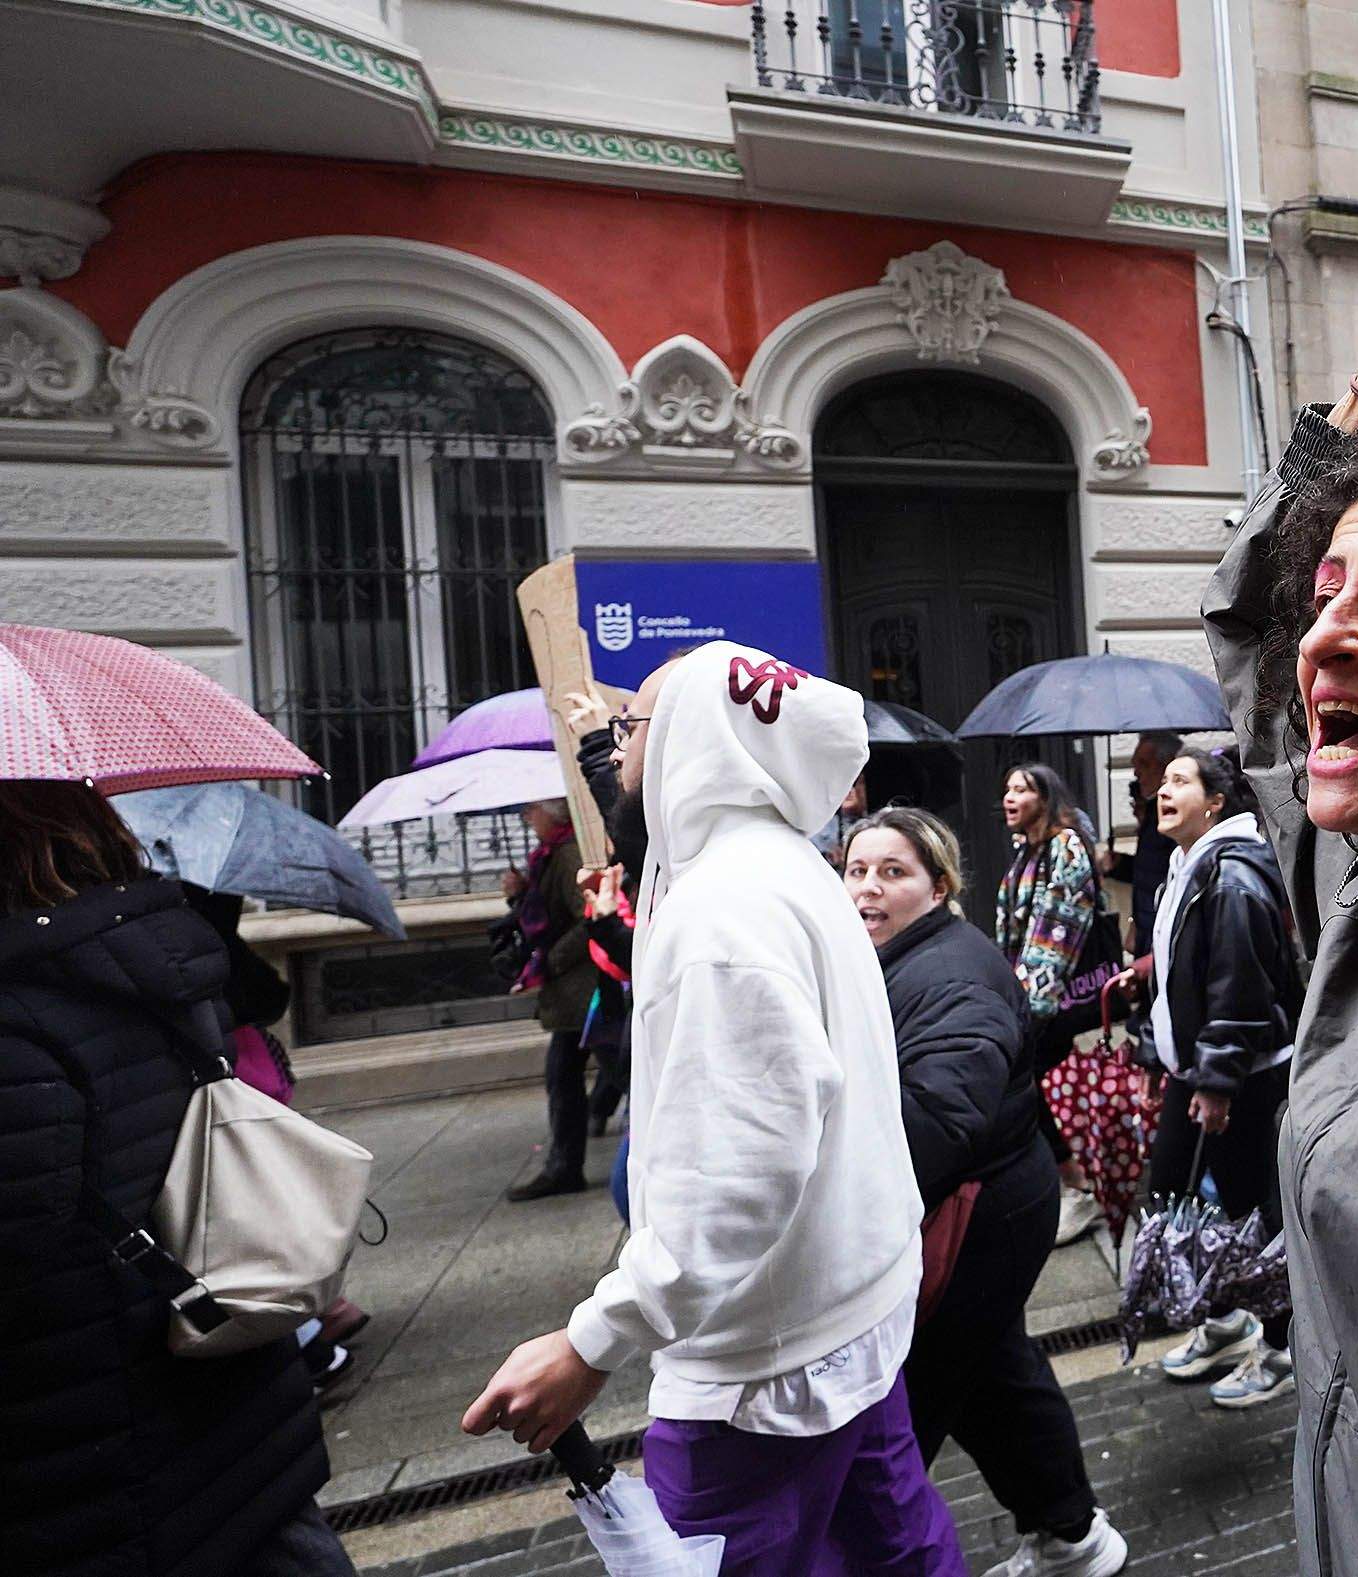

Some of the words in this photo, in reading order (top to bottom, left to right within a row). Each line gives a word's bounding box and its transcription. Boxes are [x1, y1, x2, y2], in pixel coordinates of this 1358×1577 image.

[637, 615, 692, 627] Concello
[639, 628, 655, 639] de
[656, 626, 725, 639] Pontevedra
